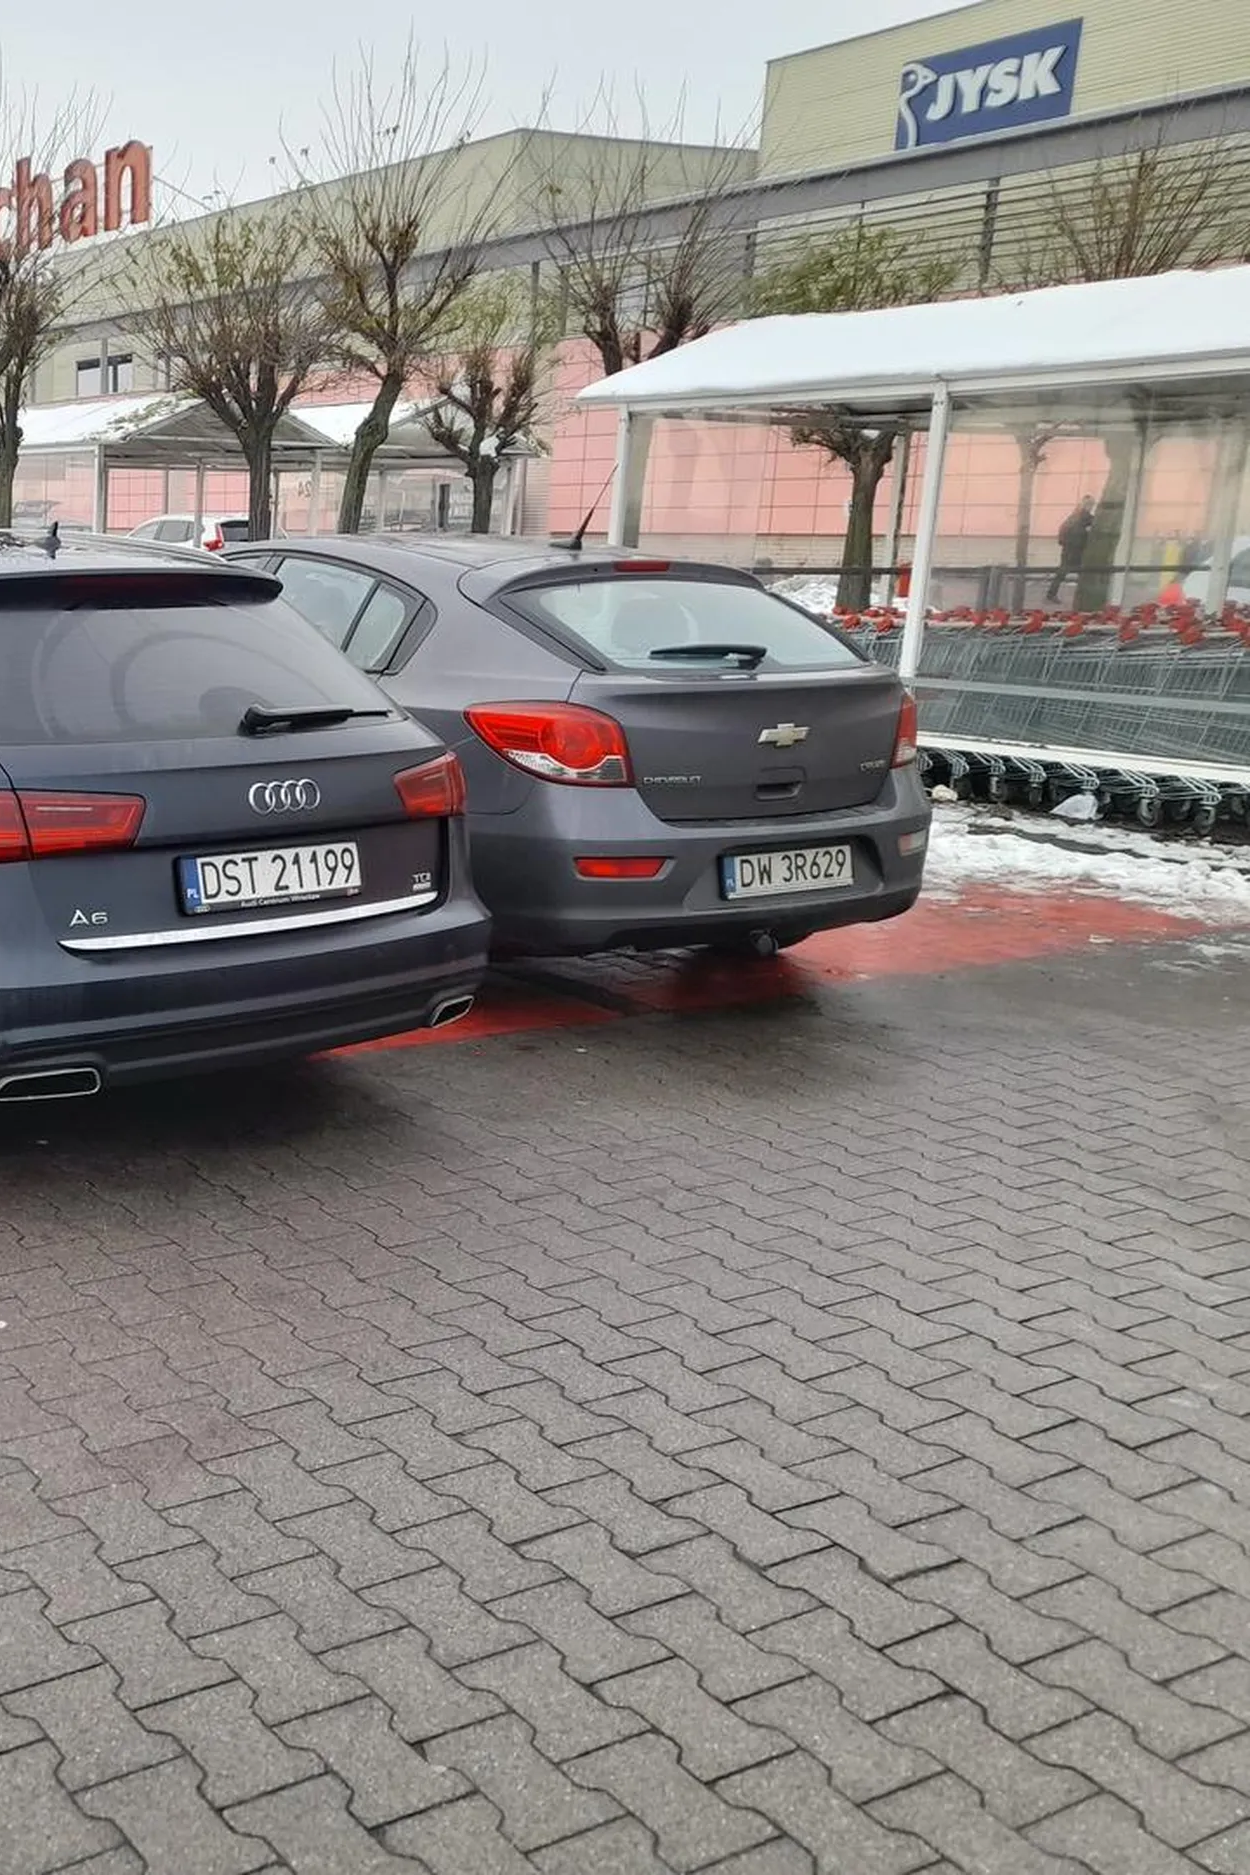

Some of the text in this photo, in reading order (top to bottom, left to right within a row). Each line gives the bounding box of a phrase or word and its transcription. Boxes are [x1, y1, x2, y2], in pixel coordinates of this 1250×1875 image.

[926, 44, 1068, 121] JYSK
[200, 847, 356, 899] DST 21199
[739, 849, 847, 888] DW 3R629
[187, 888, 200, 898] PL
[69, 908, 109, 927] A6
